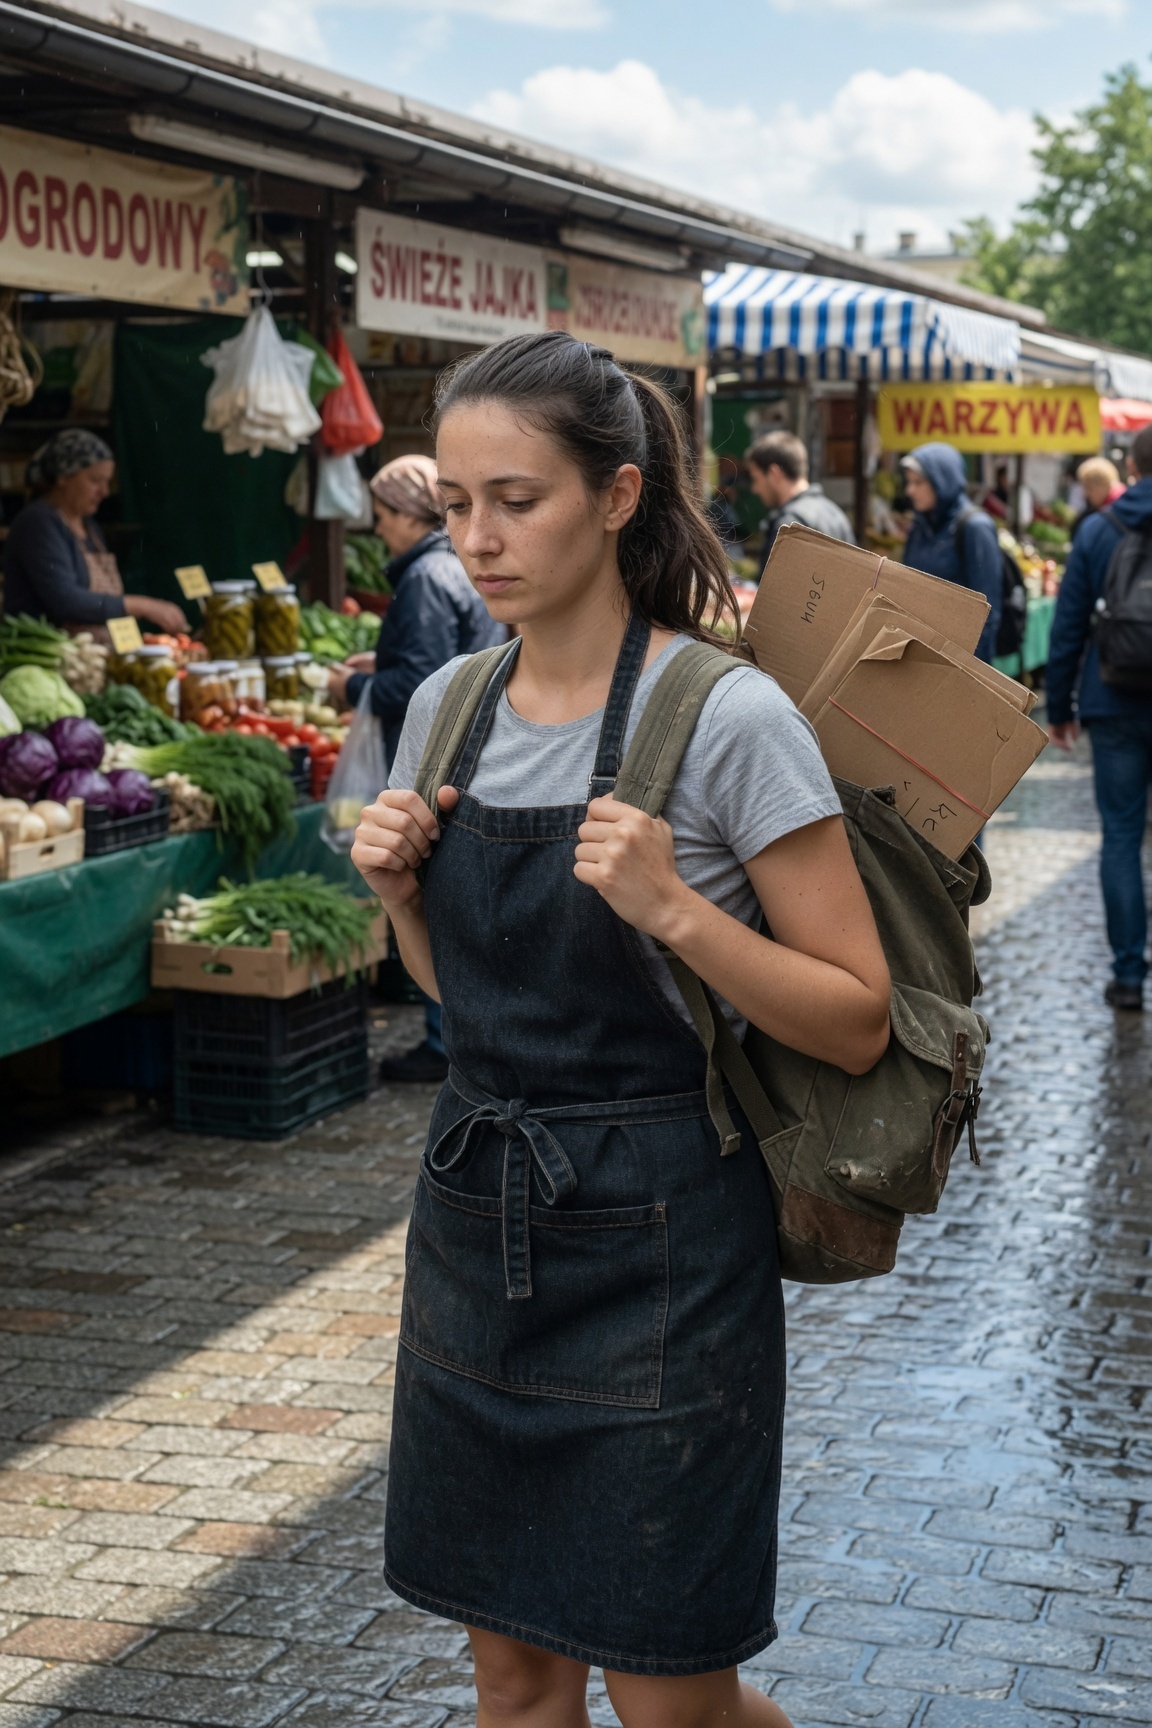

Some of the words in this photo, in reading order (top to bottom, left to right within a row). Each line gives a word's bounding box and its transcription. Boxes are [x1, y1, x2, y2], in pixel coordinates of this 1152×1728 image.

[370, 225, 463, 311] ŚWIEŻE
[468, 260, 539, 322] JAJKA
[891, 397, 1087, 436] WARZYWA
